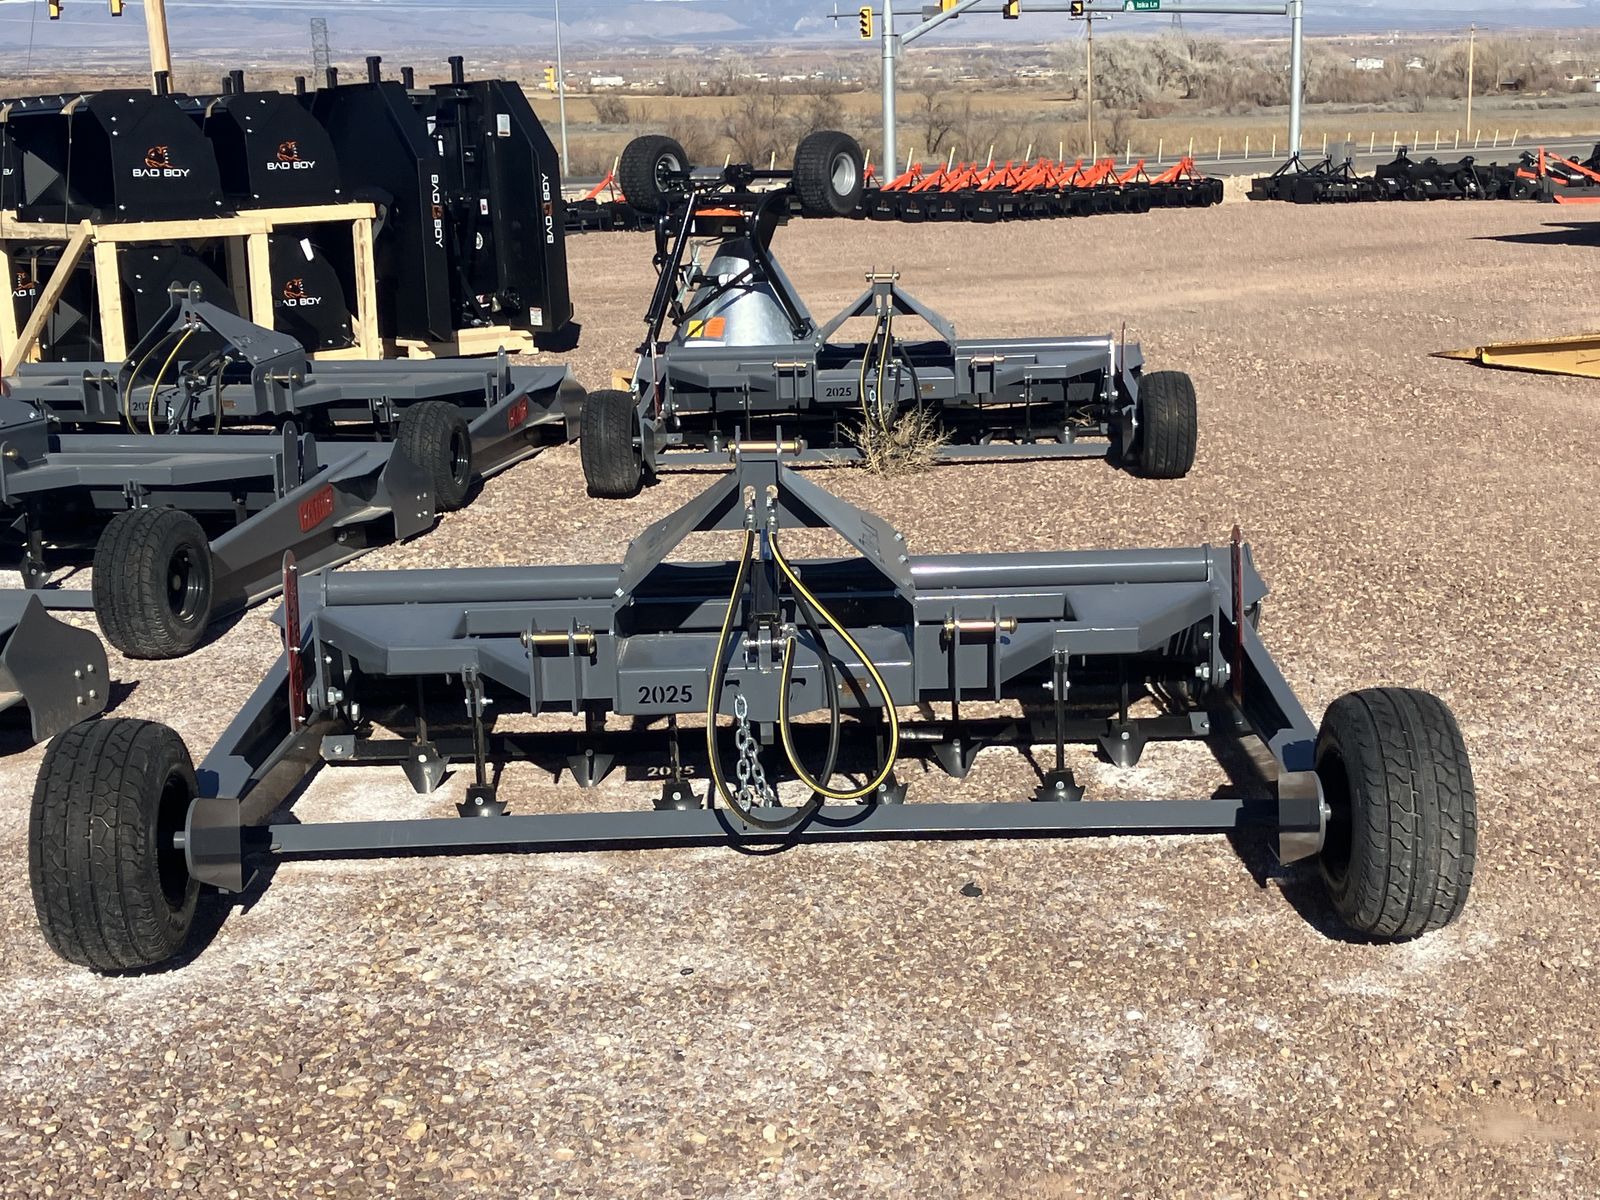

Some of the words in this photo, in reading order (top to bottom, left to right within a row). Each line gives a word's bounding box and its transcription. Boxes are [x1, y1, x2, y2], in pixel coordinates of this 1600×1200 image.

[266, 161, 290, 170] BAD
[293, 161, 315, 169] BOY
[132, 168, 160, 177] BAD
[163, 168, 190, 177] BOY
[431, 174, 440, 204] BAD
[541, 173, 551, 201] BOY
[434, 219, 443, 248] BOY
[545, 216, 554, 244] BAD
[12, 289, 27, 297] AD
[299, 296, 322, 306] BOY
[825, 387, 852, 397] 2025
[638, 685, 693, 704] 2025
[647, 765, 696, 777] 205
